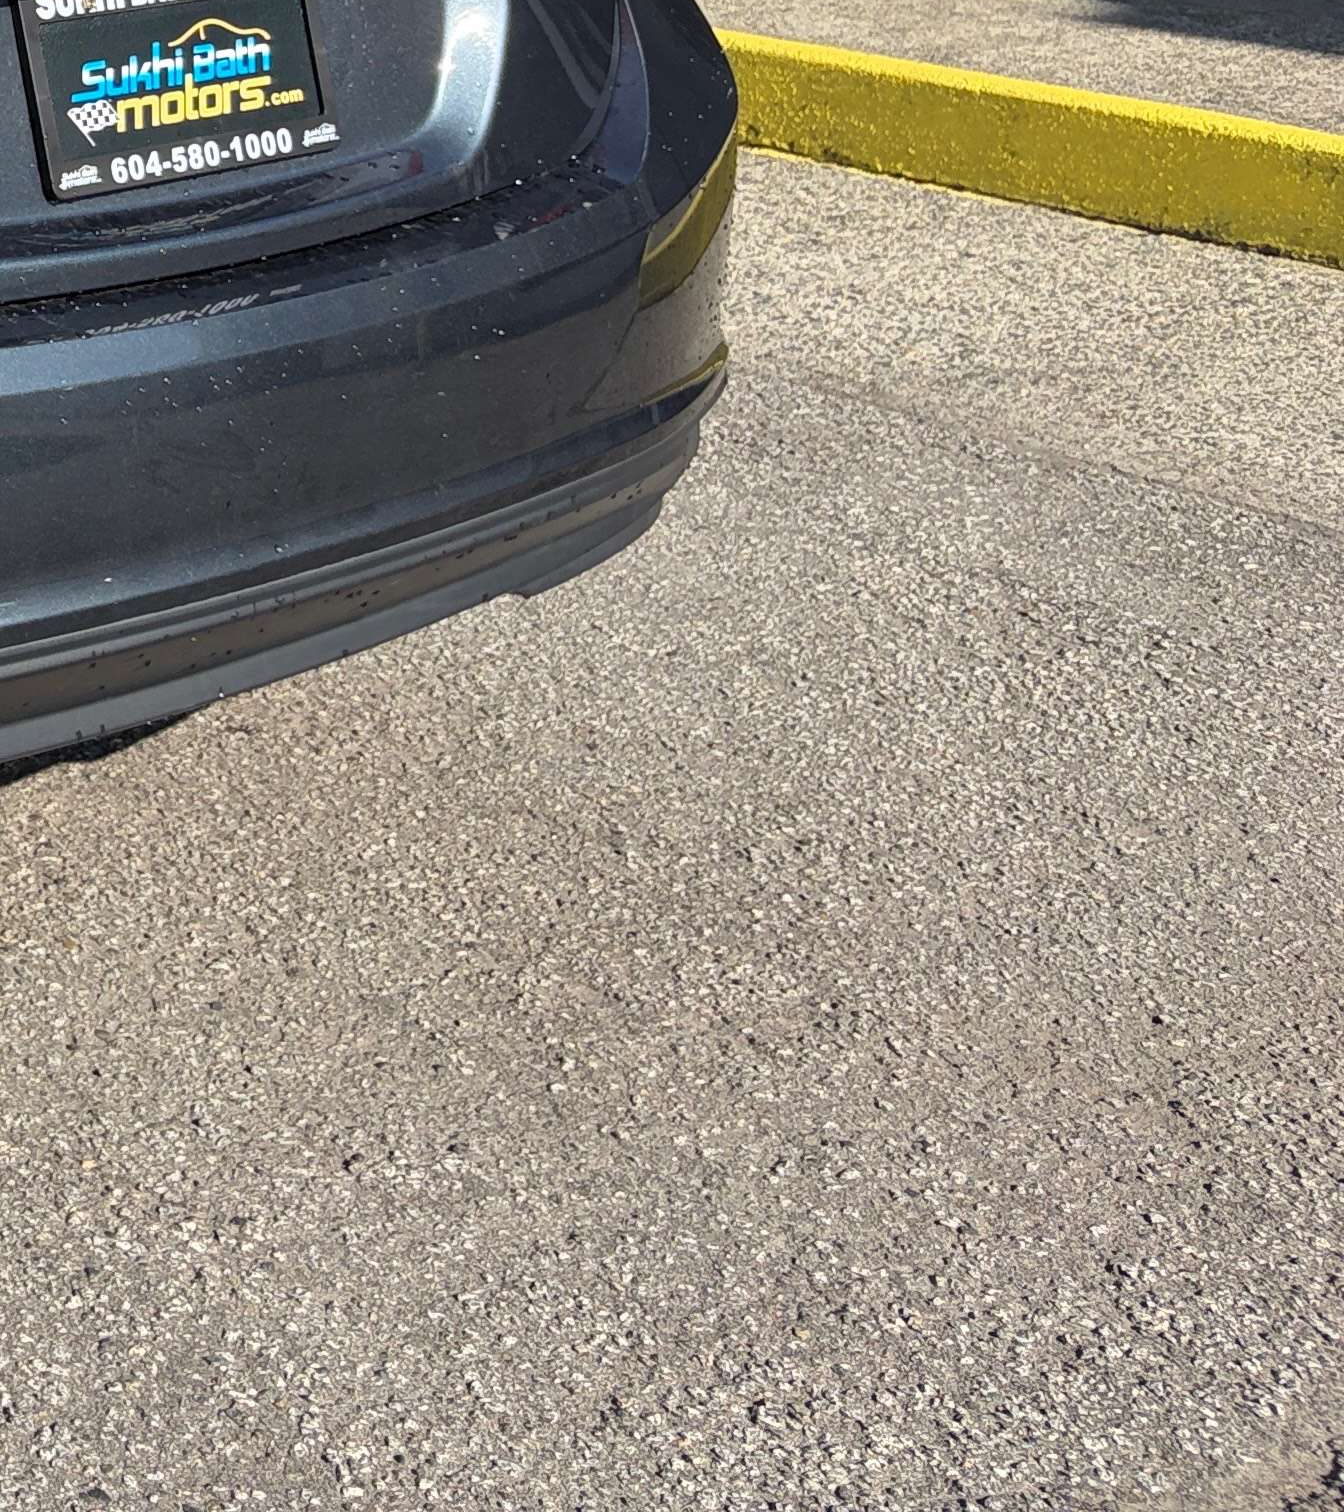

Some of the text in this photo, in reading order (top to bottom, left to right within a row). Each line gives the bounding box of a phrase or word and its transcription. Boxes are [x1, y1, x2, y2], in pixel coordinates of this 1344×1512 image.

[71, 37, 271, 103] Sukhi Bath
[110, 128, 293, 184] 604-580-1000
